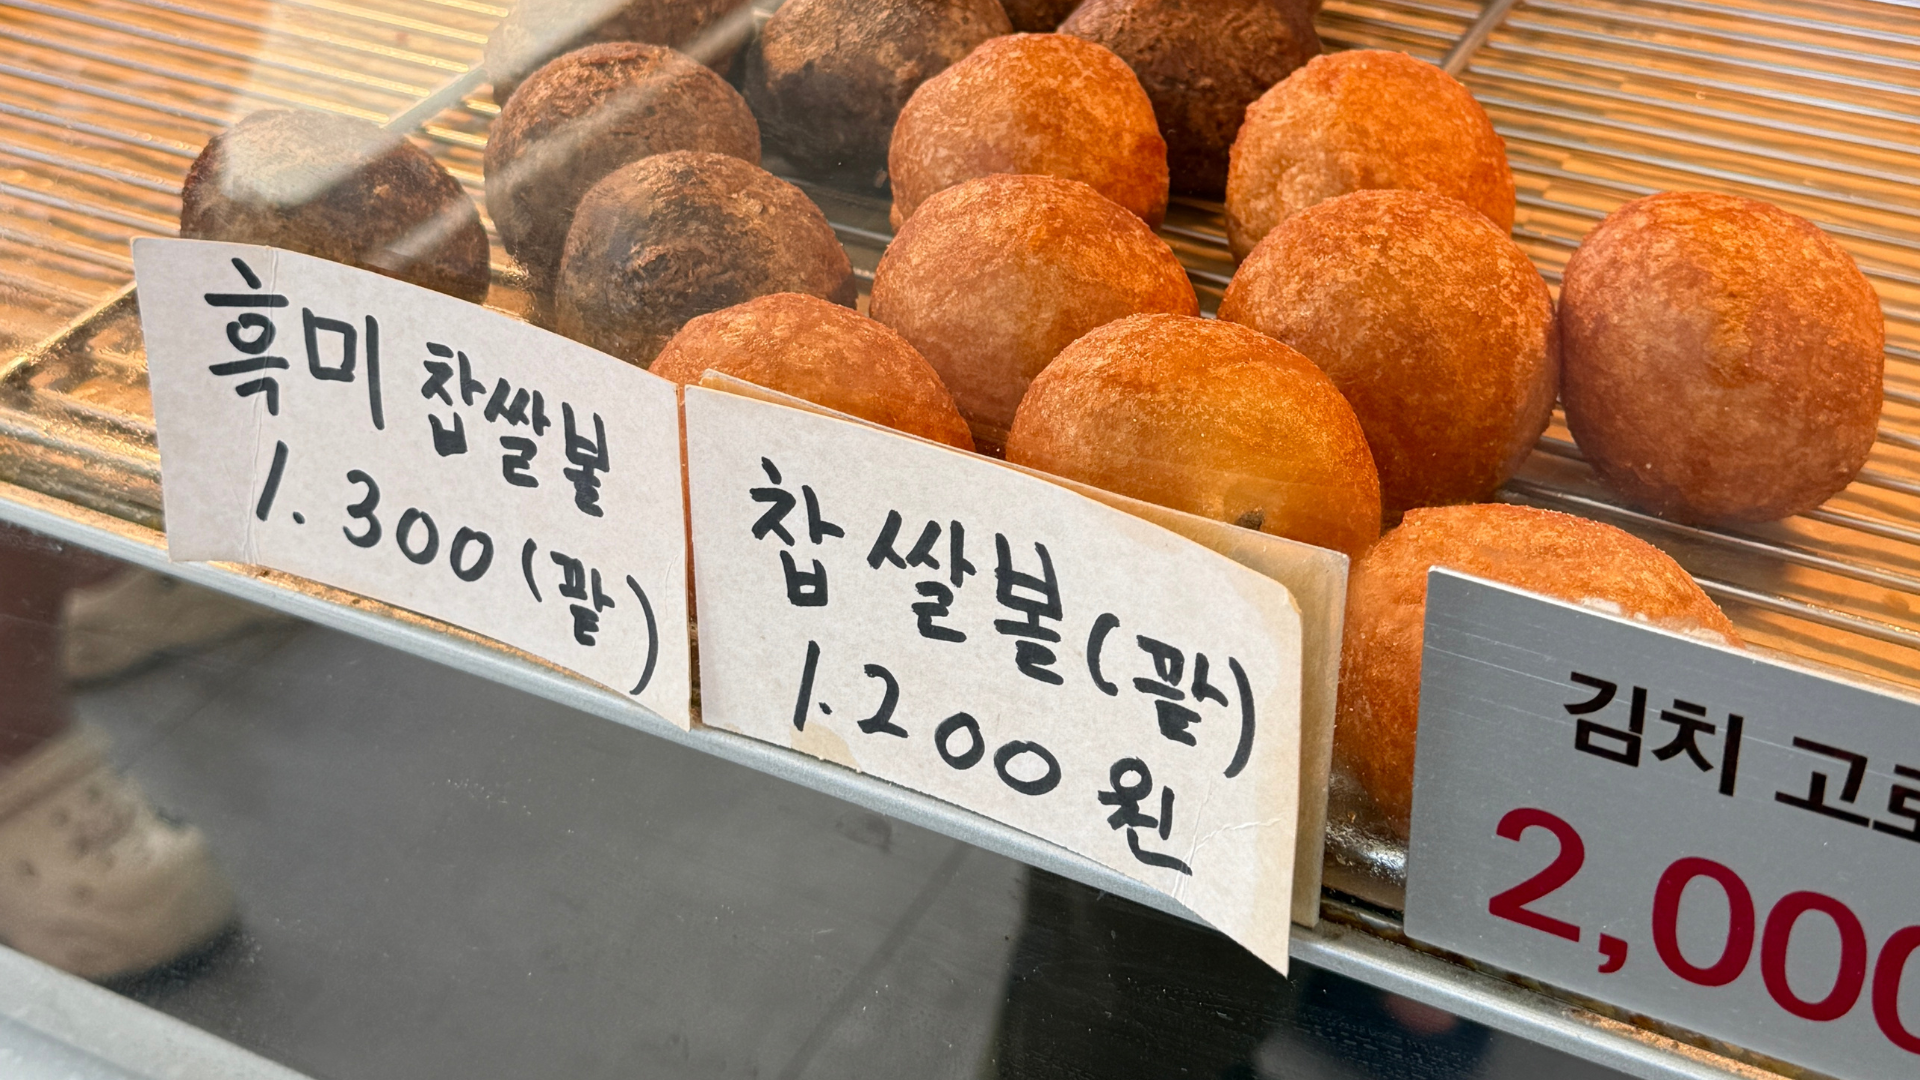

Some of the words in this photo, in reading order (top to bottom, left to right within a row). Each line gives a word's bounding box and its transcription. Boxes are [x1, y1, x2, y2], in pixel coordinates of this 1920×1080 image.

[203, 257, 385, 430] 흑미
[421, 341, 610, 518] 찹쌀볼
[1563, 671, 1744, 797] 김치
